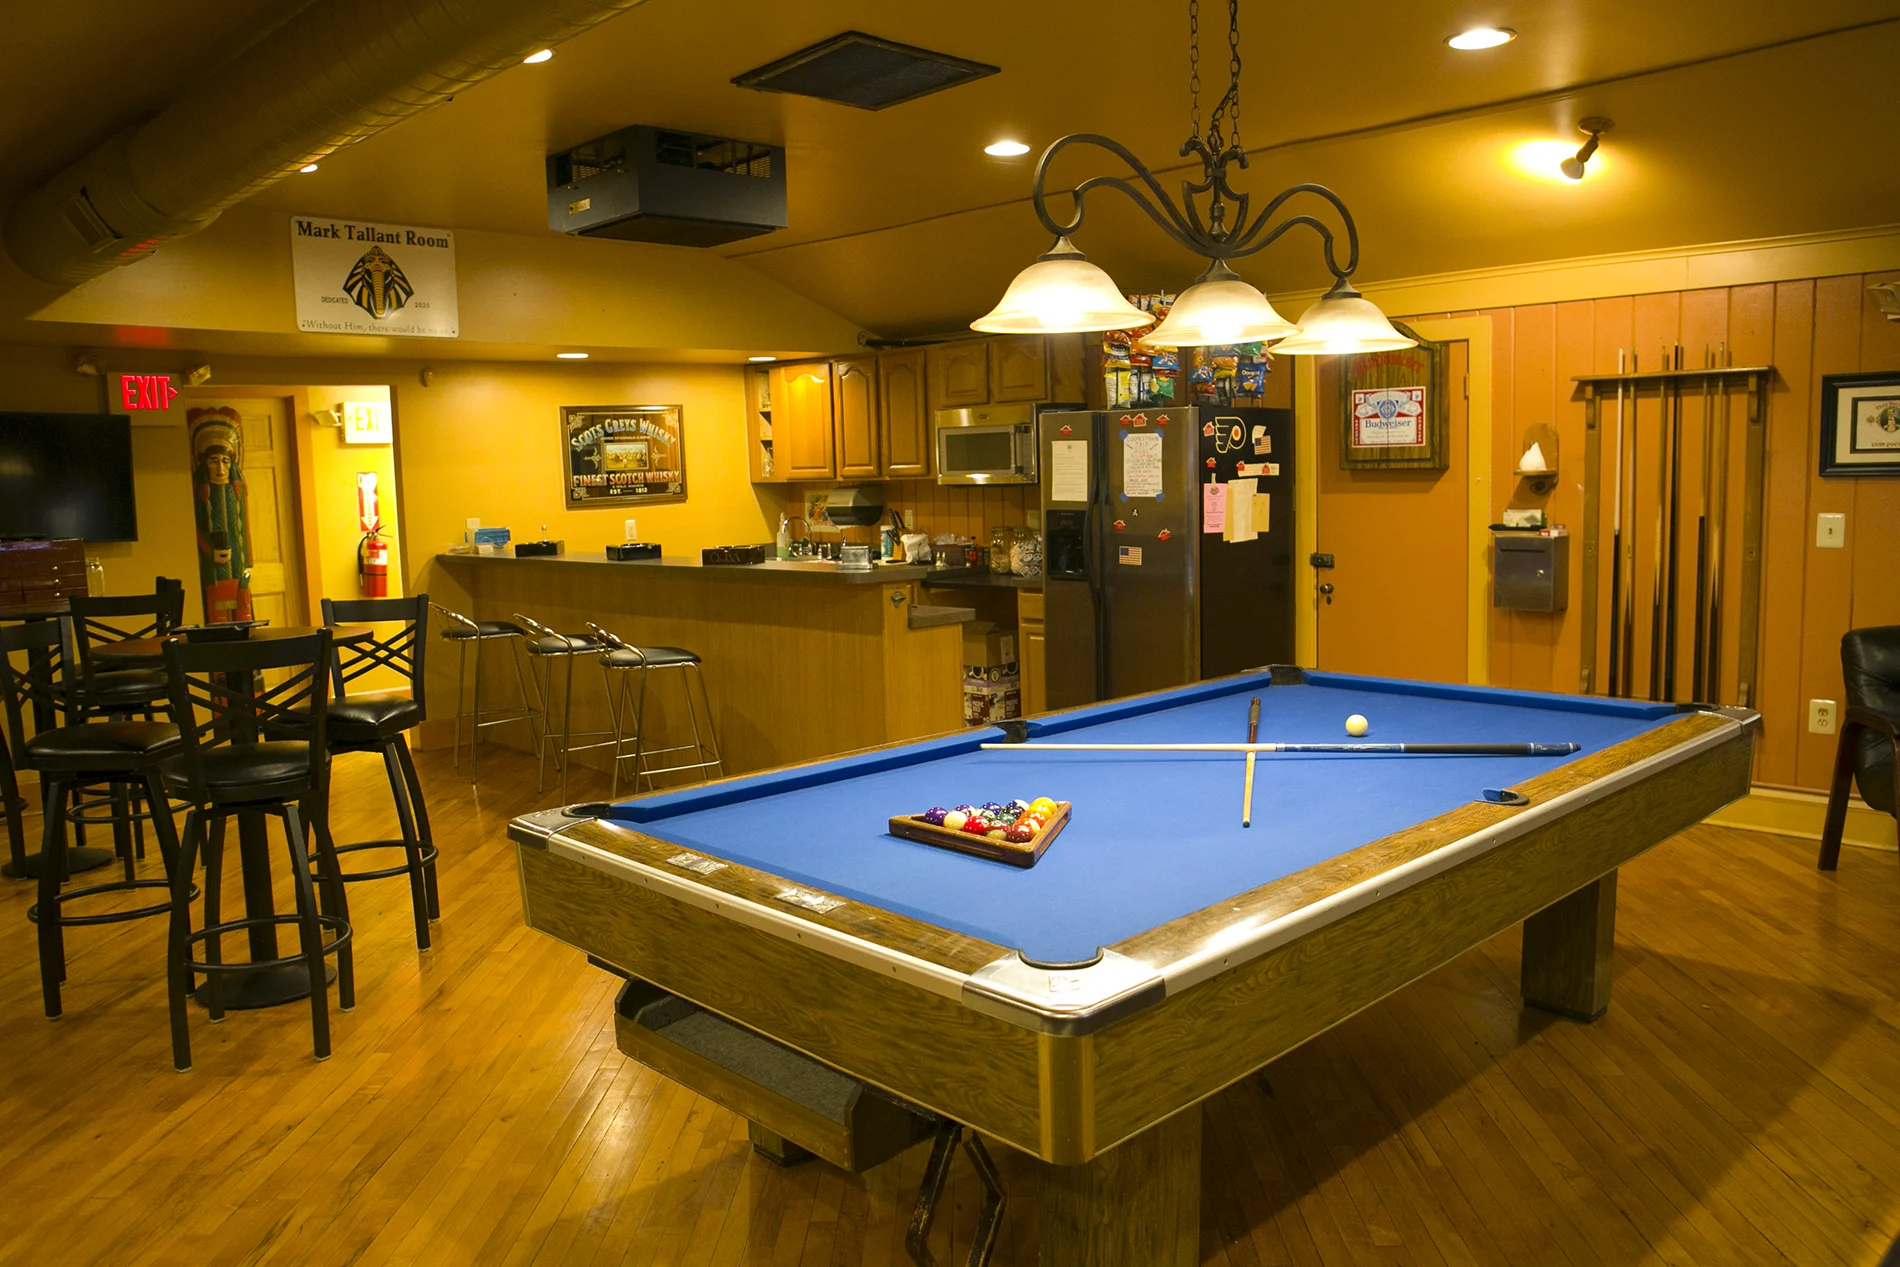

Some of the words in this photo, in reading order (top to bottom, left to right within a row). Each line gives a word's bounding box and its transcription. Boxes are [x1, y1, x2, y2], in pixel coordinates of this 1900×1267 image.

[296, 220, 340, 239] Mark
[344, 224, 402, 244] Tallant
[406, 230, 449, 248] Room
[321, 296, 348, 304] DEDICATED
[414, 301, 431, 309] 2020
[344, 321, 367, 332] Him,
[369, 323, 389, 332] there
[391, 324, 415, 334] would
[417, 325, 428, 334] be
[120, 375, 170, 411] EXIT
[1365, 419, 1412, 429] Budweiser
[571, 424, 605, 452] SCOTS
[604, 418, 637, 434] GREYS
[639, 418, 677, 448] WHISKY
[573, 473, 609, 487] FINEST
[609, 472, 645, 485] SCOTCH
[645, 470, 680, 483] WHISKY
